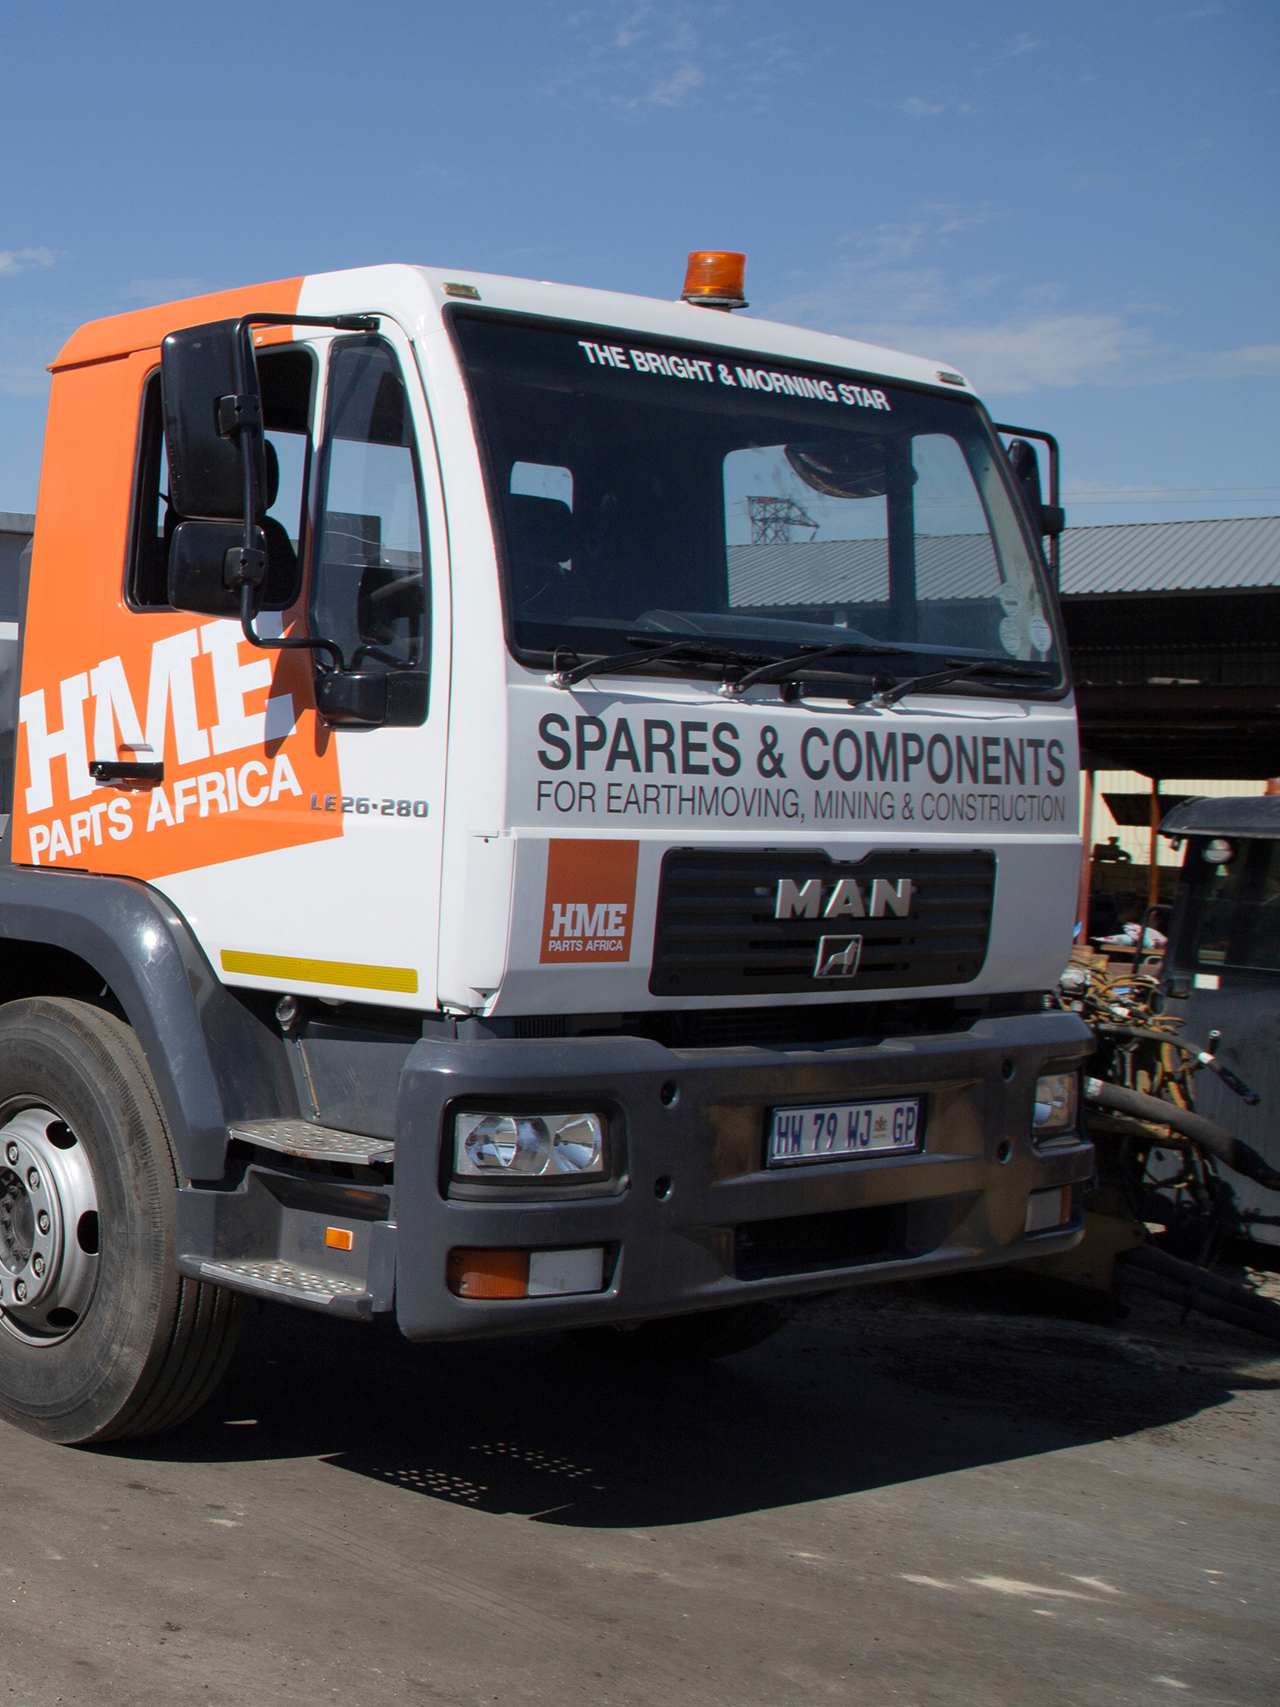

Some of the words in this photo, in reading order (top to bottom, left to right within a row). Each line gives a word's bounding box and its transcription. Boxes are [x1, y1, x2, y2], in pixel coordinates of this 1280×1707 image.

[578, 340, 631, 370] THE
[629, 349, 715, 382] BRIGHT
[718, 364, 736, 386] &
[735, 367, 838, 402] MORNING
[837, 383, 891, 411] STAR
[20, 611, 297, 814] HME
[537, 712, 742, 777] SPARES
[756, 725, 787, 779] &
[800, 726, 1066, 787] COMPONENTS
[29, 797, 133, 865] PARTS
[147, 753, 303, 832] AFRICA
[537, 780, 597, 813] FOR
[606, 782, 805, 824] EARTHMOVING,
[814, 789, 896, 821] MINING
[901, 792, 915, 821] &
[921, 792, 1066, 822] CONSTRUCTION
[549, 903, 628, 937] HME
[775, 878, 913, 919] MAN
[548, 940, 584, 952] PARTS
[585, 940, 624, 952] AFRICA
[776, 1114, 804, 1154] HW
[813, 1112, 838, 1151] 79
[846, 1110, 873, 1148] WJ
[892, 1106, 917, 1144] GP
